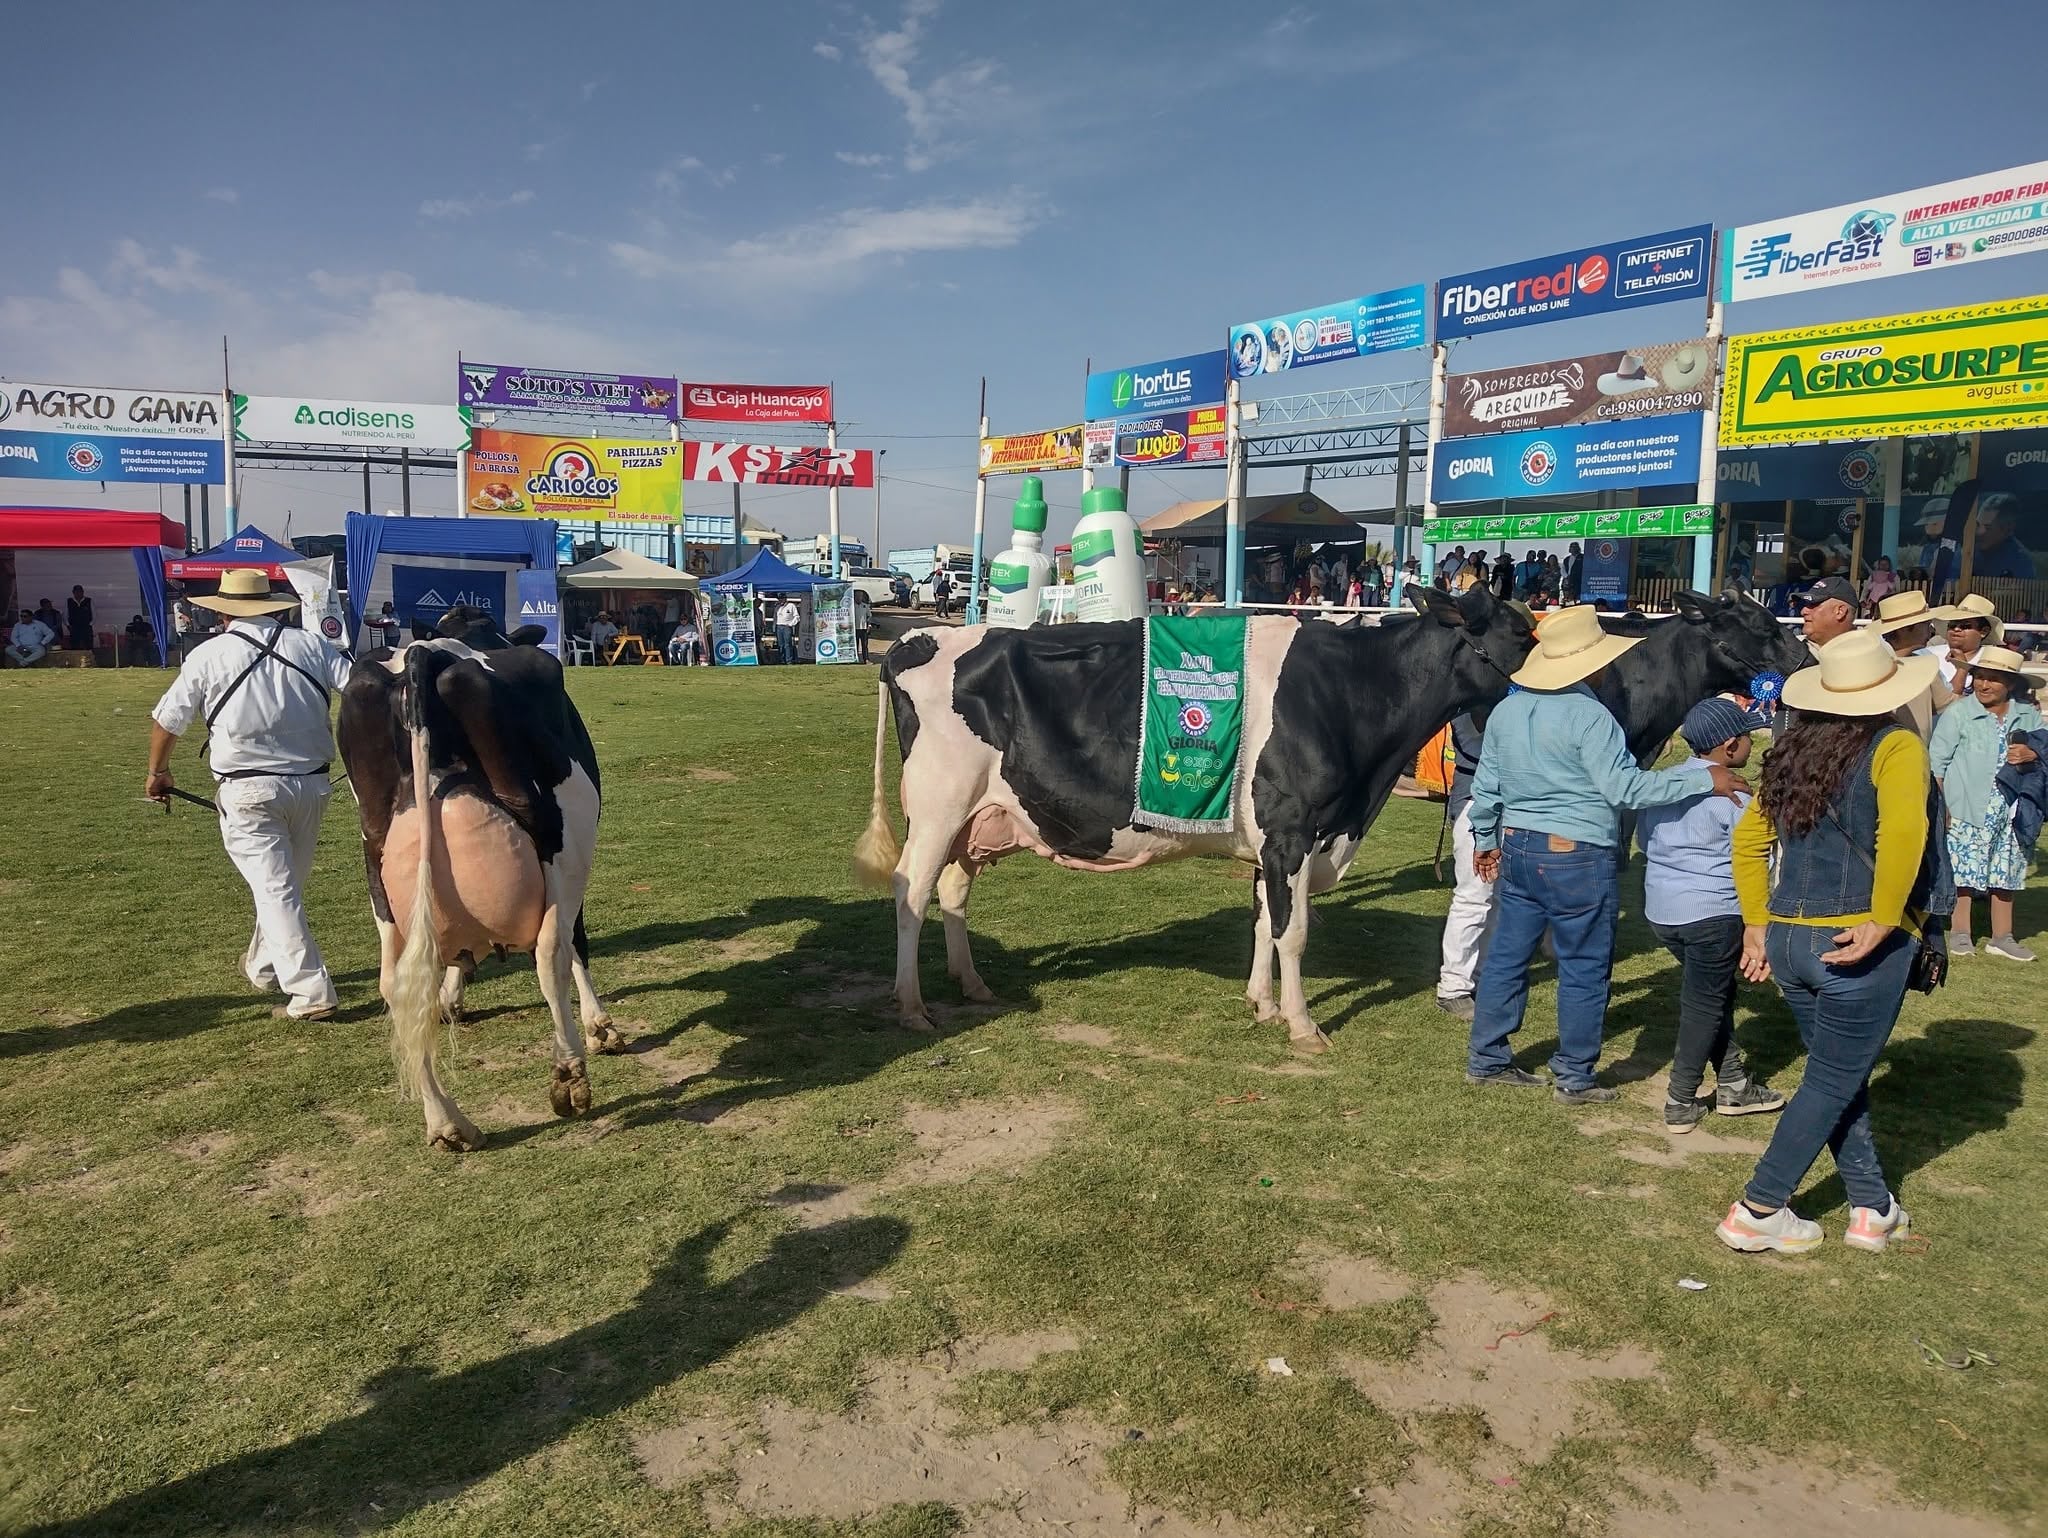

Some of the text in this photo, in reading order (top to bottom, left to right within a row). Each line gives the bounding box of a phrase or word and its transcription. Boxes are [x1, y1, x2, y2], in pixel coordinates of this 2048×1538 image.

[1907, 196, 1980, 222] INTERNER
[1982, 188, 2014, 206] POR
[1911, 206, 2034, 241] ALTA VELOCIDAD
[1626, 244, 1695, 267] INTERNET
[1623, 268, 1694, 291] TELEVISIÓN
[1803, 270, 1829, 280] Internet
[1829, 269, 1841, 277] por
[1841, 265, 1859, 273] Fibra
[1463, 298, 1570, 326] CONEXIÓN QUE NOS UNE
[1819, 346, 1882, 361] GRUPO
[506, 375, 634, 399] SOTO'S VET
[1133, 367, 1191, 397] hortus
[1484, 369, 1556, 393] SOMBREROS
[509, 391, 631, 407] ALIMENTOS BALANCEADOS
[1966, 382, 2018, 400] avgust
[15, 388, 218, 426] AGRO GANA
[716, 391, 823, 410] Caja Huancayo
[1143, 397, 1175, 409] Acompañamos
[1180, 394, 1192, 403] éxito
[1485, 389, 1559, 417] AREQUIPA
[318, 407, 415, 429] adisens
[745, 409, 800, 418] La Caja del Perú
[1501, 415, 1538, 429] ORIGINAL
[178, 426, 210, 435] CORP.
[341, 430, 385, 439] NUTRIENDO
[396, 432, 416, 440] PERÚ
[1119, 418, 1163, 435] RADIADORES
[1003, 434, 1045, 450] UNIVERSO
[1136, 434, 1182, 458] LUQUE
[1575, 443, 1592, 454] Día
[1600, 439, 1616, 450] día
[1616, 440, 1635, 449] con
[1636, 433, 1680, 447] nuestros
[173, 450, 208, 458] nuestros
[475, 451, 518, 462] POLLOS A
[607, 446, 677, 458] PARRILLAS Y
[991, 447, 1037, 464] VETERINARIO
[1575, 446, 1678, 468] productores lecheros.
[2005, 449, 2048, 468] GLORI
[121, 457, 208, 466] productores lecheros.
[125, 465, 205, 475] ¡Avanzamos juntos!
[474, 463, 520, 474] LA BRASA
[622, 458, 663, 468] PIZZAS
[1448, 456, 1494, 480] GLORIA
[1578, 460, 1673, 479] ¡Avanzamos juntos!
[526, 477, 619, 496] CARIOCOS
[608, 511, 616, 519] El
[617, 512, 639, 520] sabor
[640, 513, 649, 521] de
[237, 538, 263, 548] ABS
[452, 591, 493, 609] Alta
[536, 600, 557, 614] Alta
[719, 646, 735, 655] GPS
[1169, 736, 1218, 755] GLORIA
[1183, 756, 1223, 773] expo
